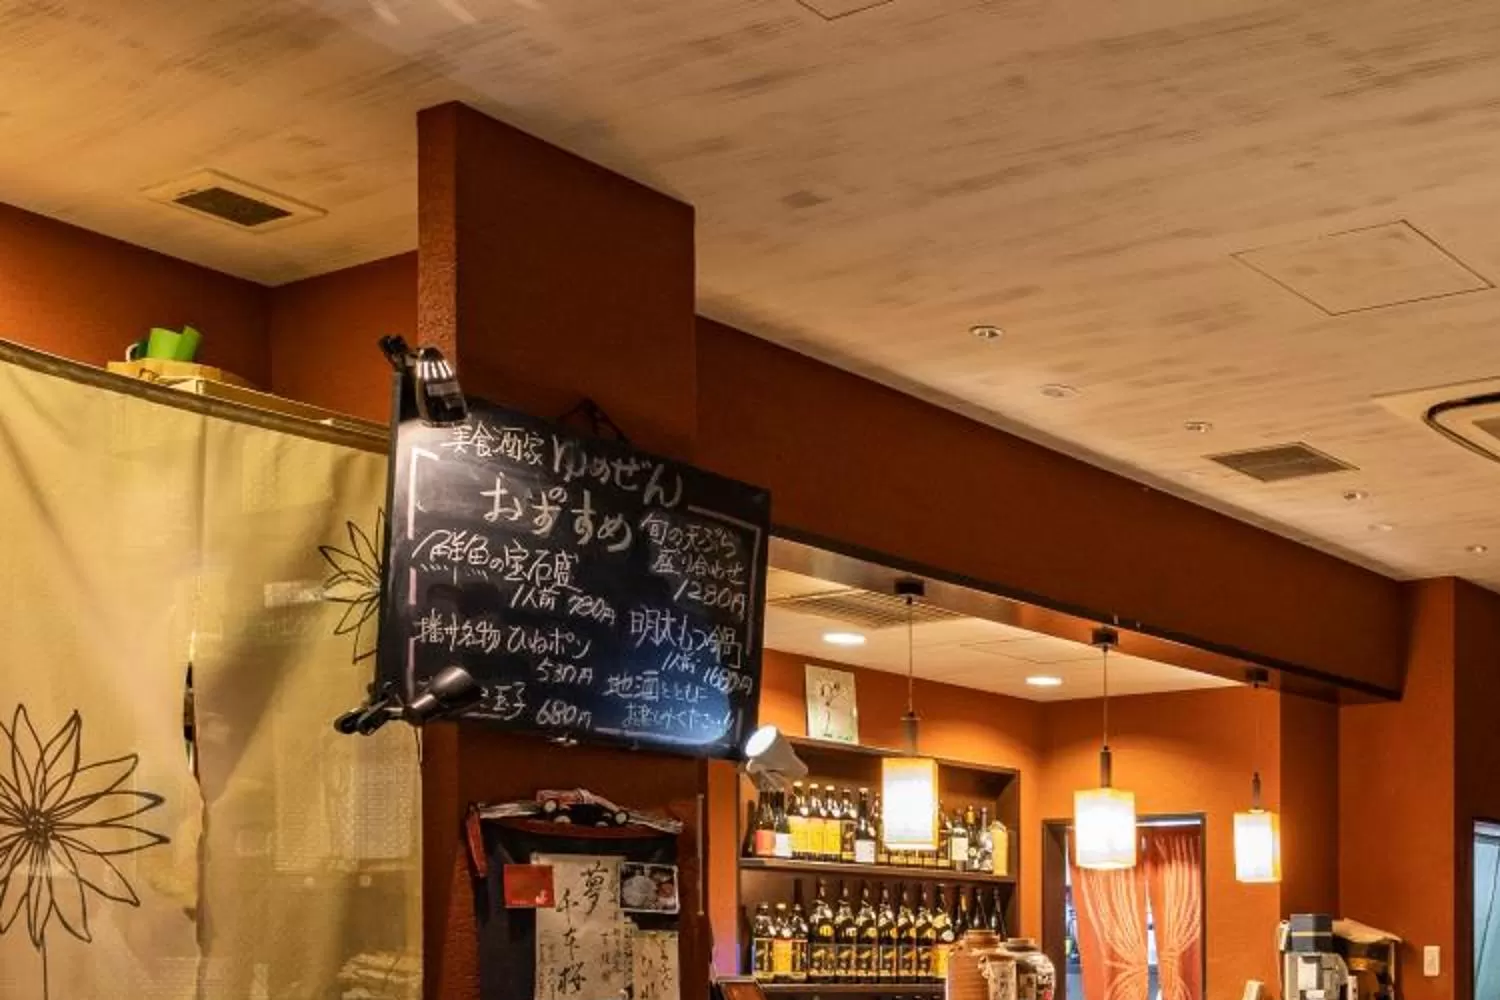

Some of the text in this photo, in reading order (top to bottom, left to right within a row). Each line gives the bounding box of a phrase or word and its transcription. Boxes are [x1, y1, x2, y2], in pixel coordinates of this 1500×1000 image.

[551, 434, 683, 508] ゆめぜん
[640, 512, 738, 558] 旬の天ぷら
[535, 699, 594, 730] 680円
